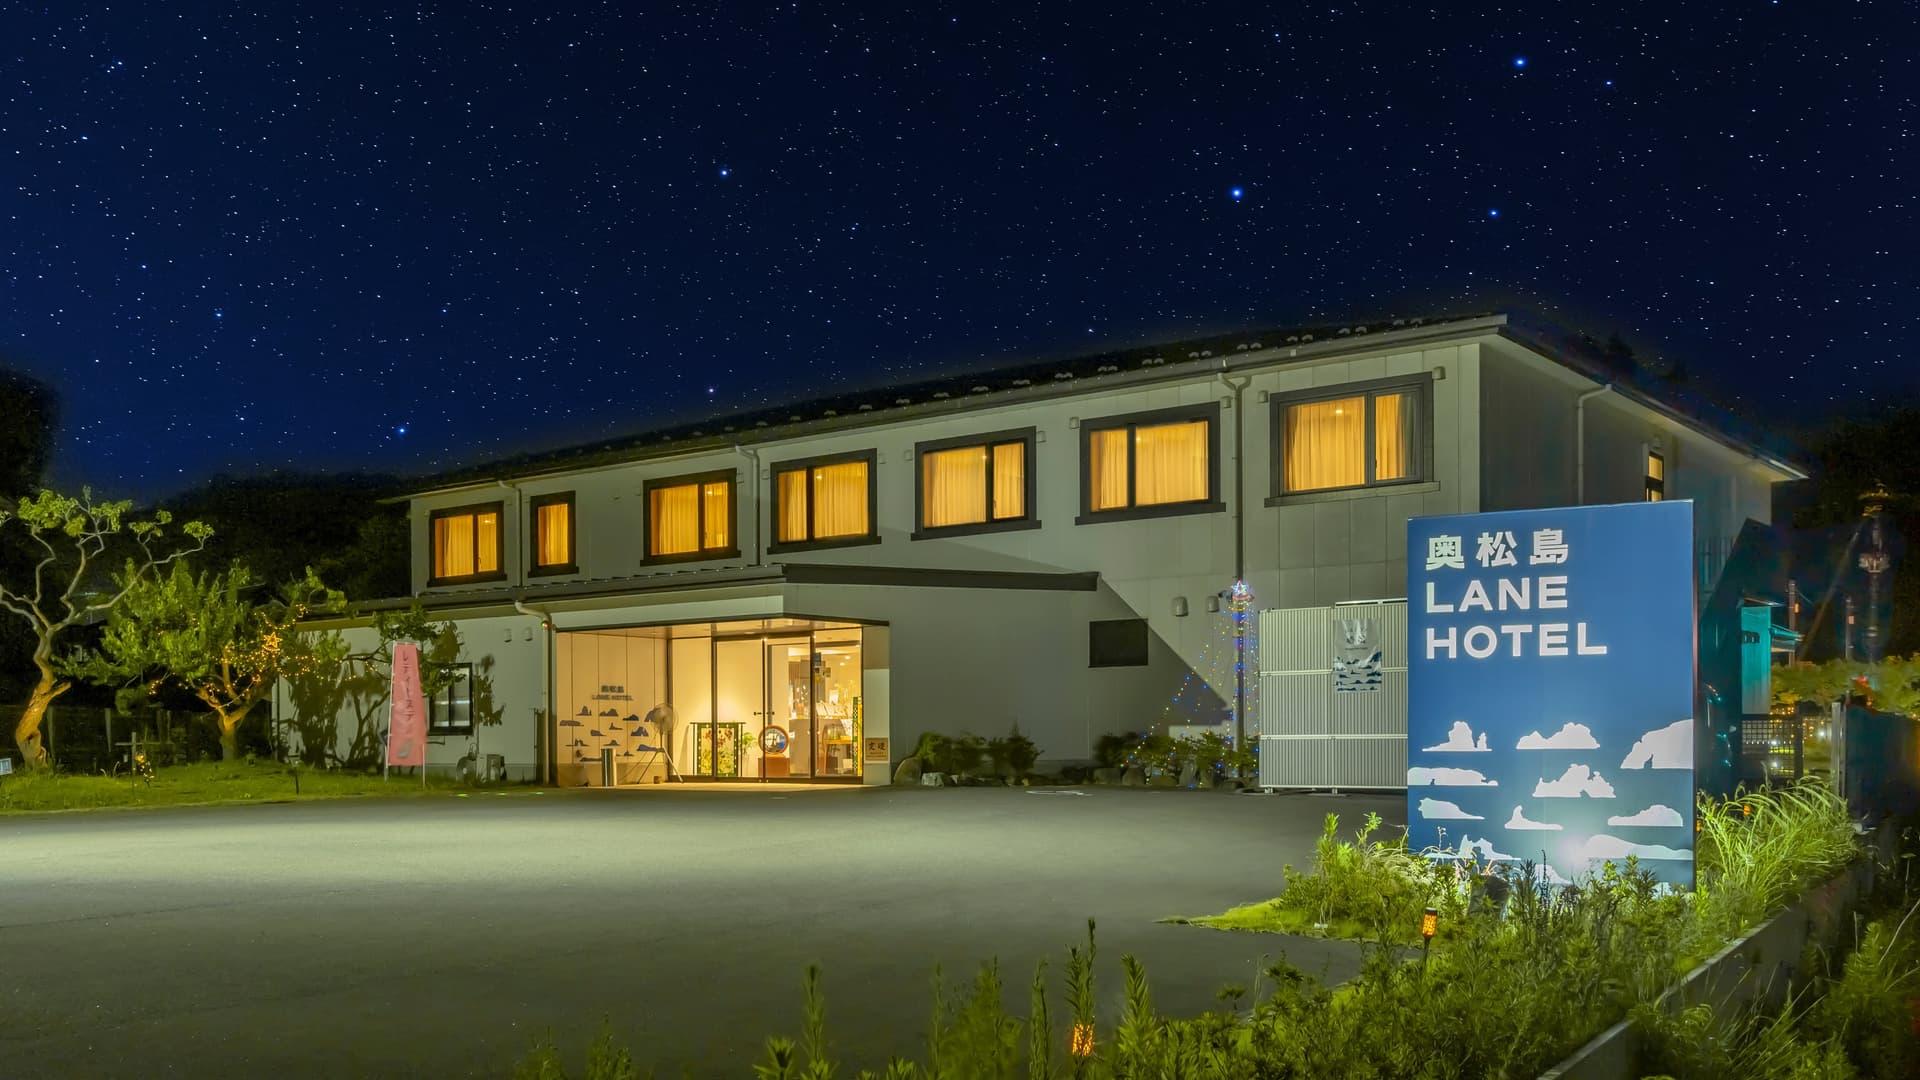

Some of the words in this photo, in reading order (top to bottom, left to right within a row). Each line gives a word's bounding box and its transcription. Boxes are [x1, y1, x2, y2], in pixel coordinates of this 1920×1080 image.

[1425, 528, 1569, 571] 奥松島
[1425, 575, 1568, 613] LANE
[1426, 622, 1608, 660] HOTEL
